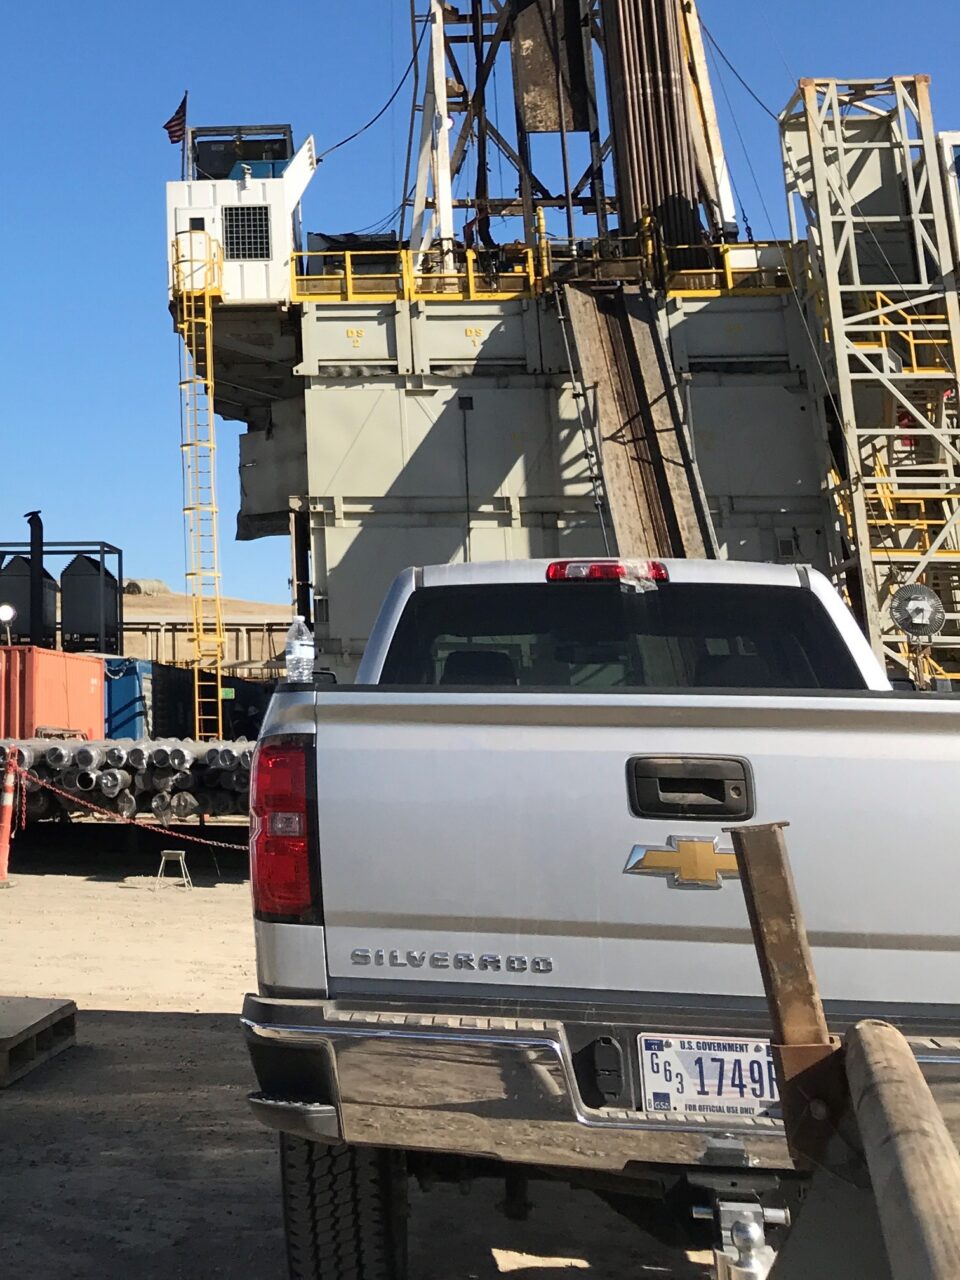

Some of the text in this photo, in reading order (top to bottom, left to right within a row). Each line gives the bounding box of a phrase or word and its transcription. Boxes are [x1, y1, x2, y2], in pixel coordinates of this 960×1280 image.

[350, 948, 553, 974] SILVERADO
[680, 1040, 749, 1053] U.S. GOVERNMENT
[685, 1103, 755, 1115] FOR OFFICIAL USE ONLY
